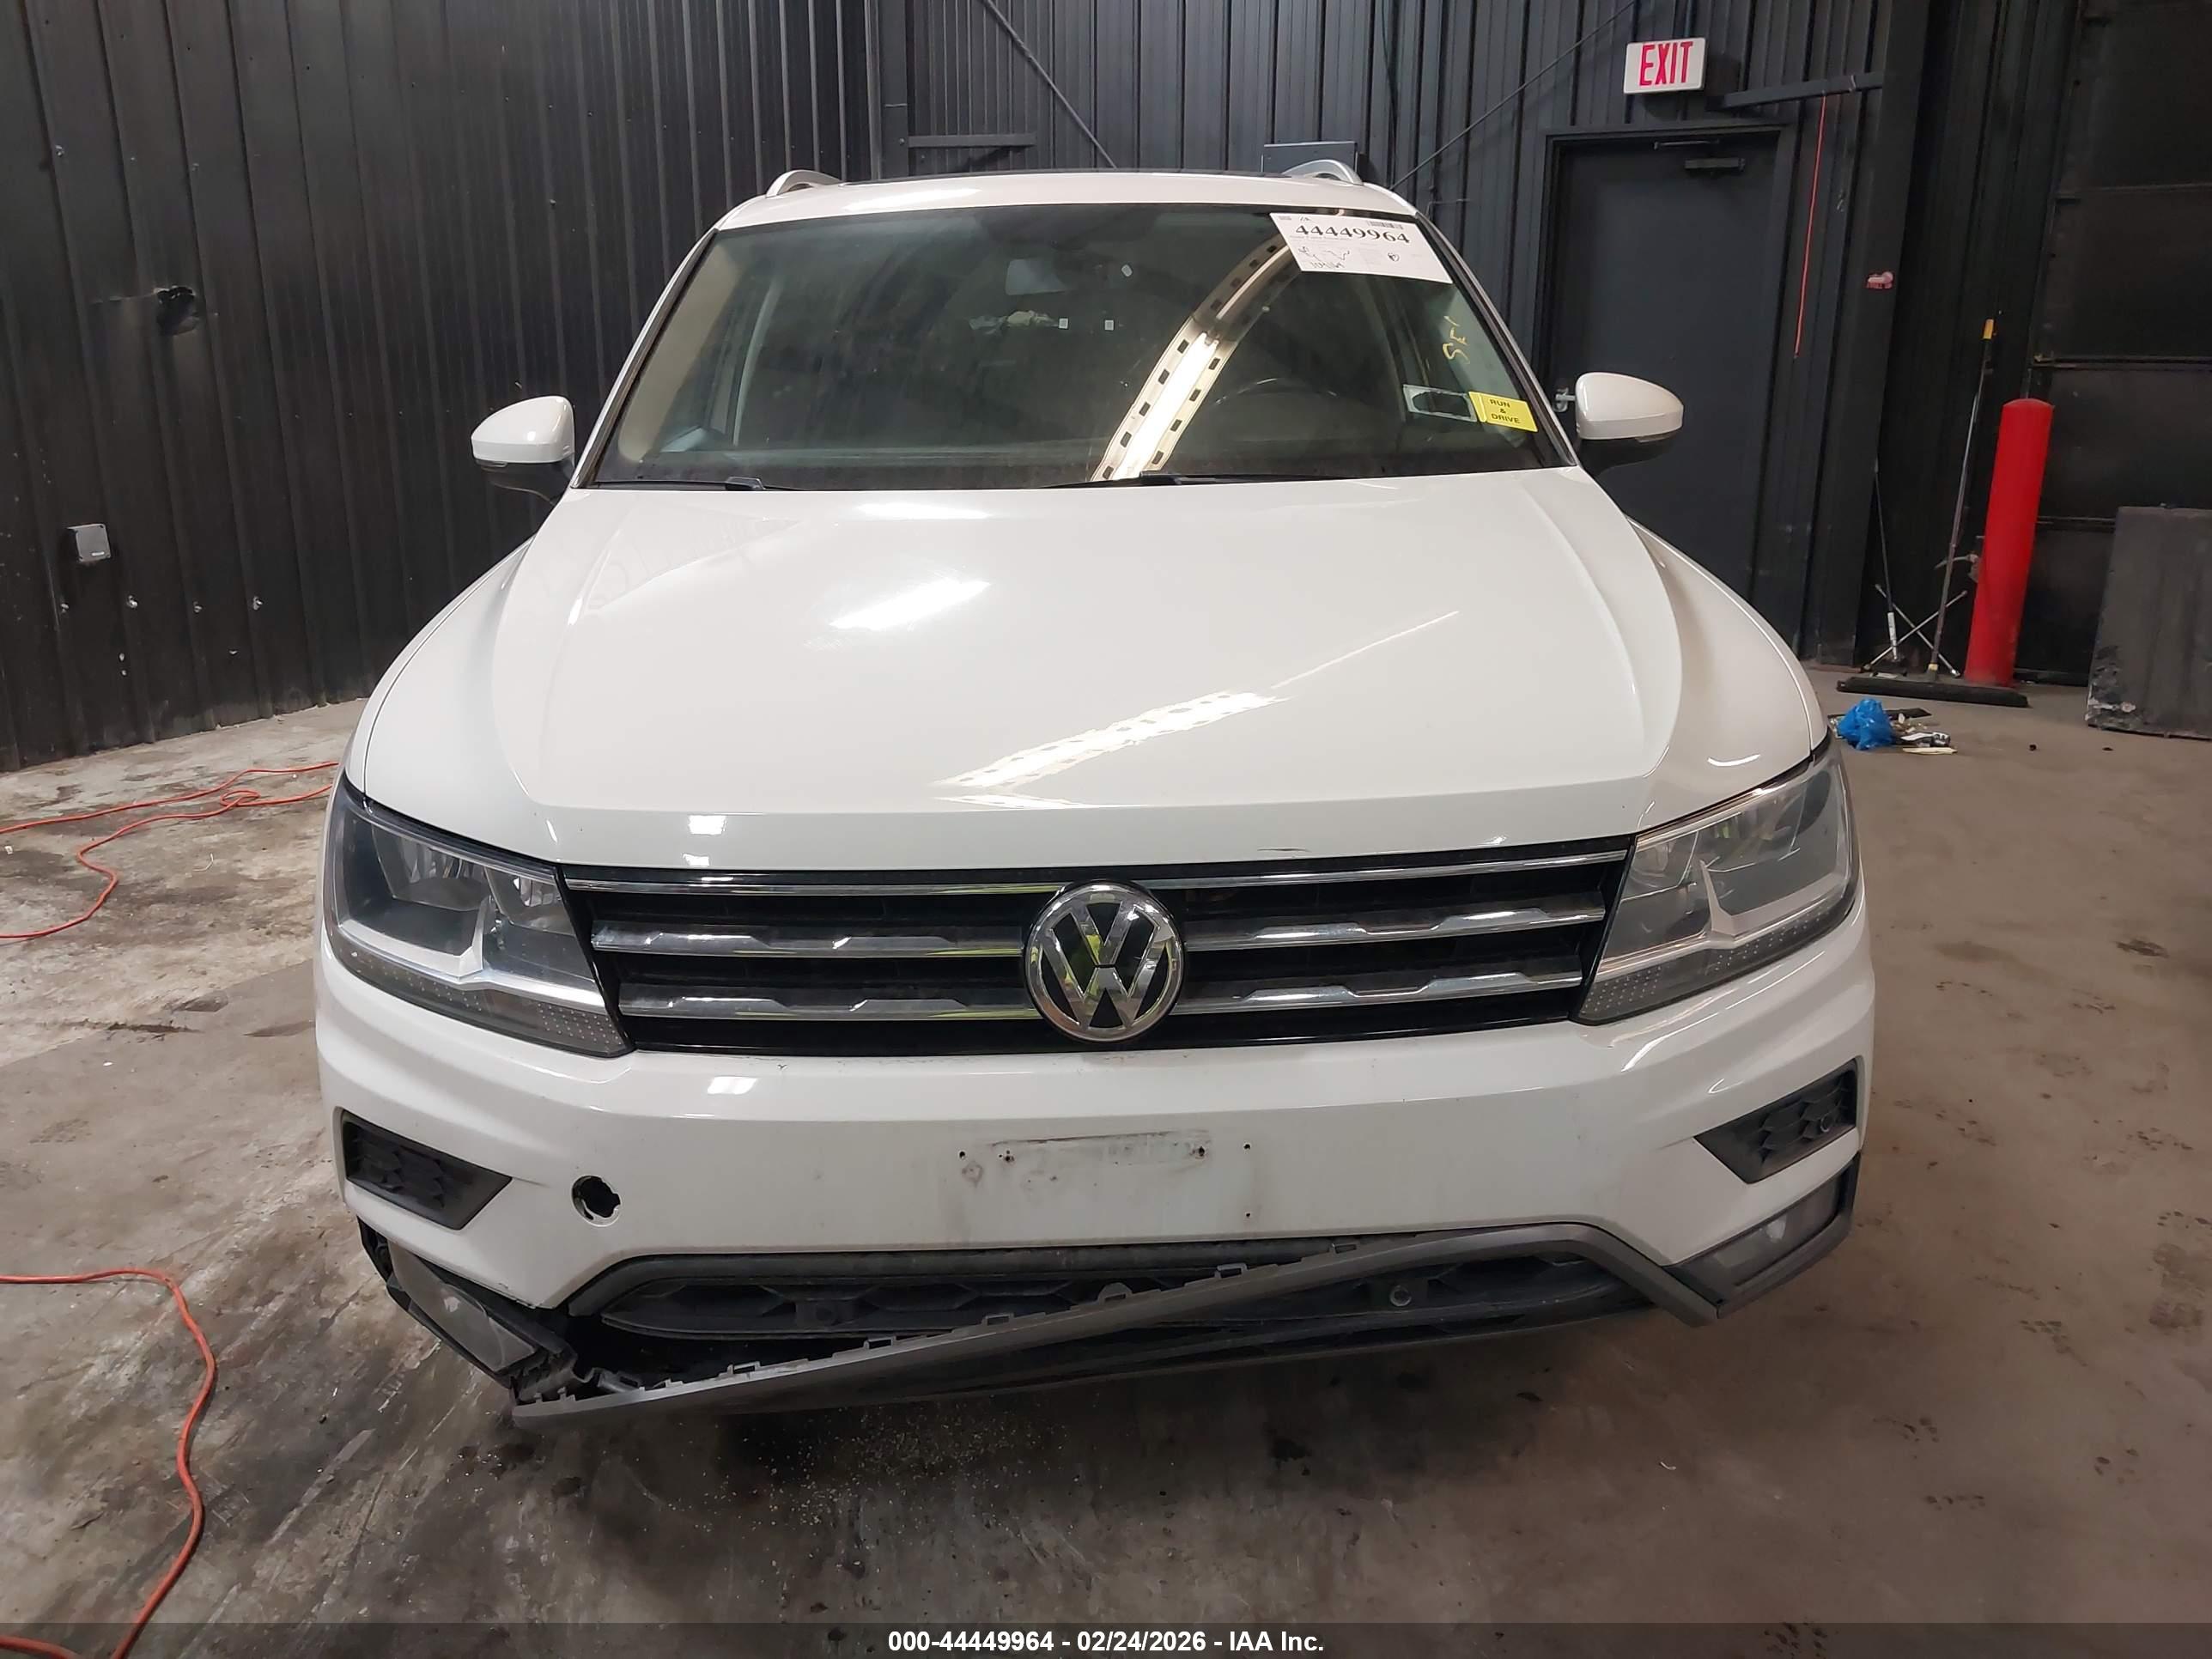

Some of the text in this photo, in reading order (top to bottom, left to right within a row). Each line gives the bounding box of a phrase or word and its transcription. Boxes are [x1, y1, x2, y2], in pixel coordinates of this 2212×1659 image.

[1639, 41, 1693, 86] EXIT
[1295, 225, 1410, 244] 44449964
[1489, 398, 1511, 408] RUN
[1491, 413, 1521, 424] DRIVE
[1030, 889, 1176, 1037] VW
